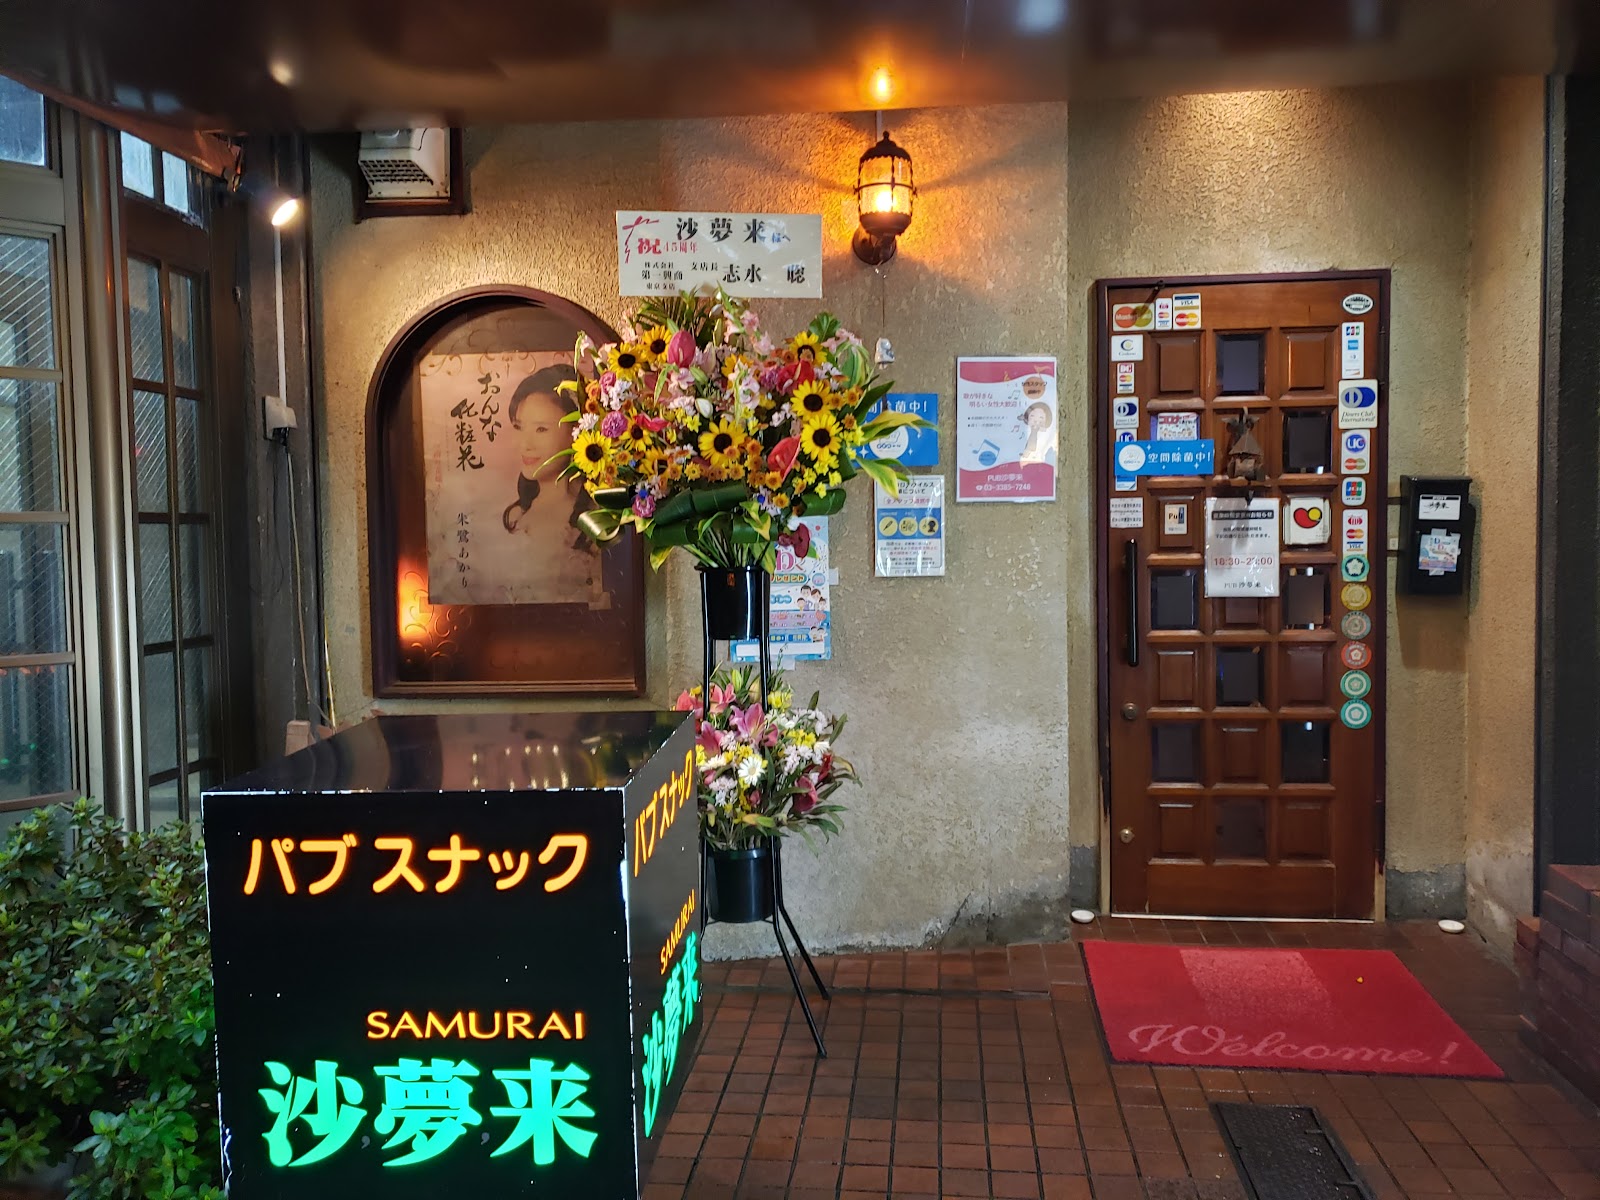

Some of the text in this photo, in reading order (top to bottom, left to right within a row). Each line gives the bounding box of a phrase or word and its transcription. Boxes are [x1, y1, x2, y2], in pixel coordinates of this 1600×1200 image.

[637, 238, 662, 255] 祝
[676, 217, 766, 244] 沙夢来
[722, 263, 762, 284] 志水
[477, 372, 502, 443] おんな
[243, 833, 588, 895] パブ スナック
[661, 889, 695, 976] SAMURAI
[367, 1010, 584, 1040] SAMURAI
[642, 931, 699, 1138] 沙夢来
[1128, 1023, 1461, 1065] Welcome!
[257, 1057, 599, 1168] 沙夢来
